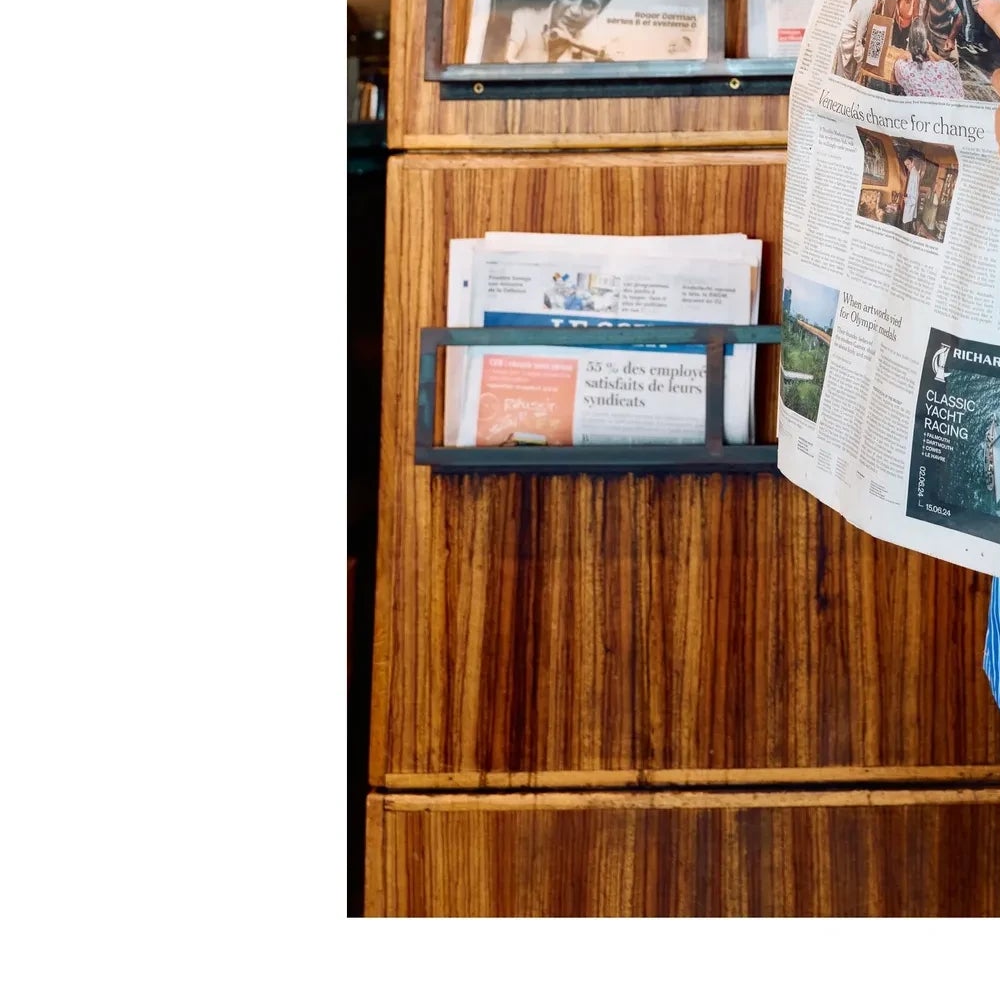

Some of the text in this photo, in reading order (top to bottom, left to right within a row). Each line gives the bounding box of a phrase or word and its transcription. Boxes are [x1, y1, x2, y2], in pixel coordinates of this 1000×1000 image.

[818, 89, 864, 122] Venezuela's
[866, 108, 909, 130] chance
[910, 114, 931, 132] for
[933, 117, 985, 142] change
[843, 291, 862, 309] When
[863, 304, 889, 321] artworks
[840, 306, 897, 342] for Olympic medals
[586, 361, 707, 382] 55 % des employé
[585, 376, 703, 394] satisfaits de leurs
[583, 393, 646, 409] syndicats
[926, 389, 976, 412] CLASSIC
[925, 403, 965, 424] YACHT
[924, 417, 969, 440] RACING
[927, 432, 951, 444] FALMOUTH
[926, 438, 954, 451] DARTMOUTH
[925, 503, 952, 517] 15.06.24
